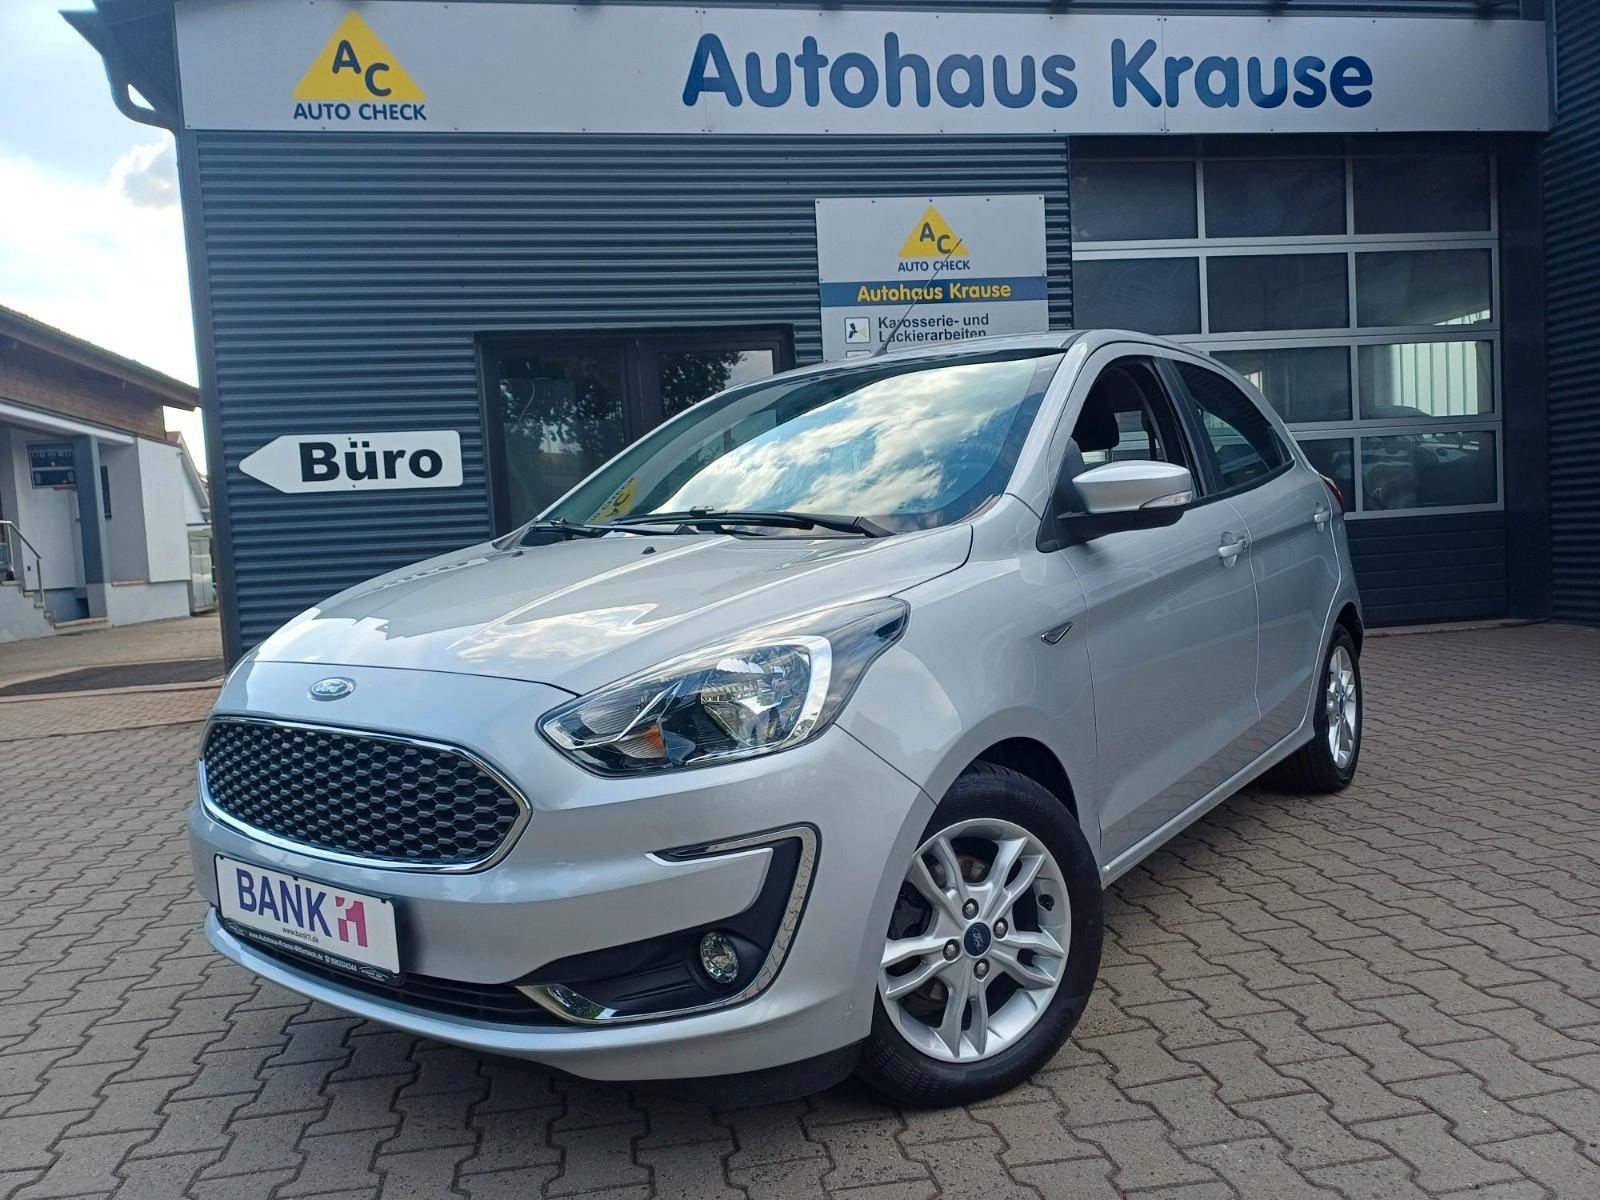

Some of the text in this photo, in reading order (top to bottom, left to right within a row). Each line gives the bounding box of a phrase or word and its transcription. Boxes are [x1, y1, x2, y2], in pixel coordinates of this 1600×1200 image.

[682, 32, 1374, 109] Autohaus Krause
[293, 103, 427, 121] AUTO CHECK
[897, 260, 970, 272] AUTO CHECK
[857, 282, 1012, 302] Autohaus Krause
[963, 313, 989, 326] und
[299, 441, 443, 482] Büro
